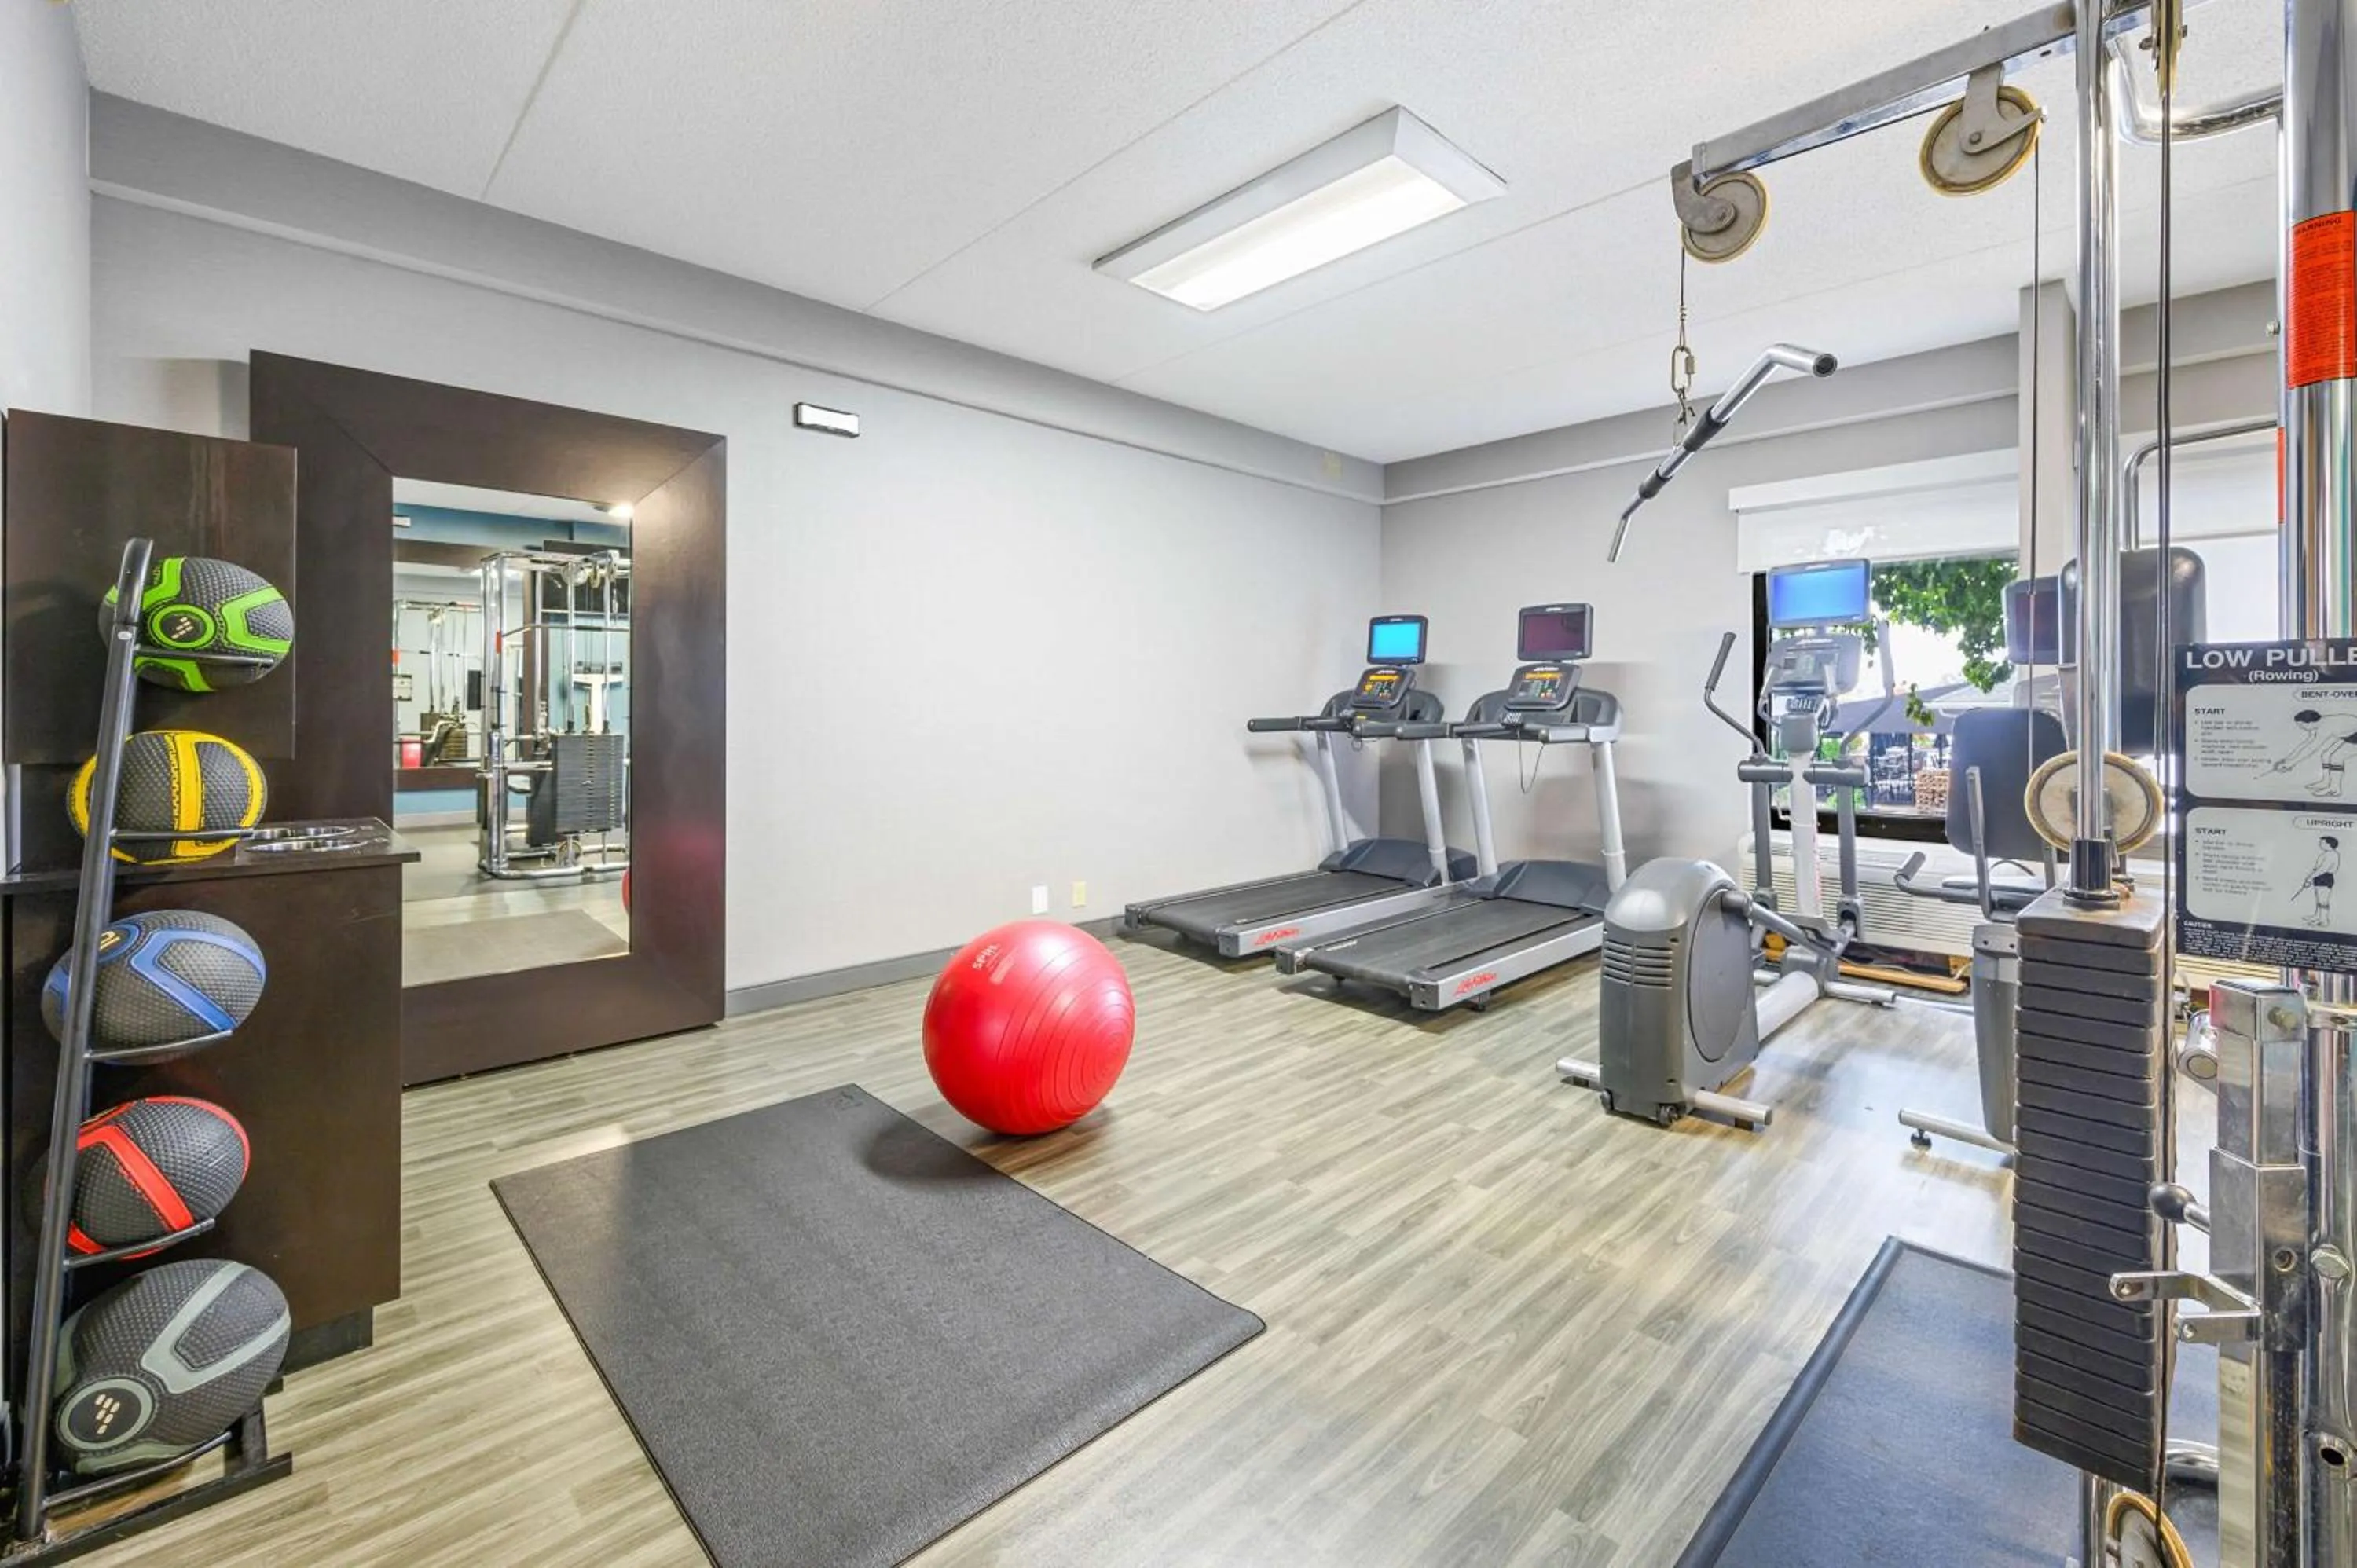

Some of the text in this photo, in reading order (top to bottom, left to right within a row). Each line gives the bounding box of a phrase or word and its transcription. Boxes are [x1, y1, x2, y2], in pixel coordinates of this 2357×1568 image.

[2187, 649, 2253, 669] LOW
[2249, 669, 2319, 683] (Rowing)
[2301, 690, 2357, 698] BENT-OVE
[2306, 819, 2354, 828] UPRIGHT
